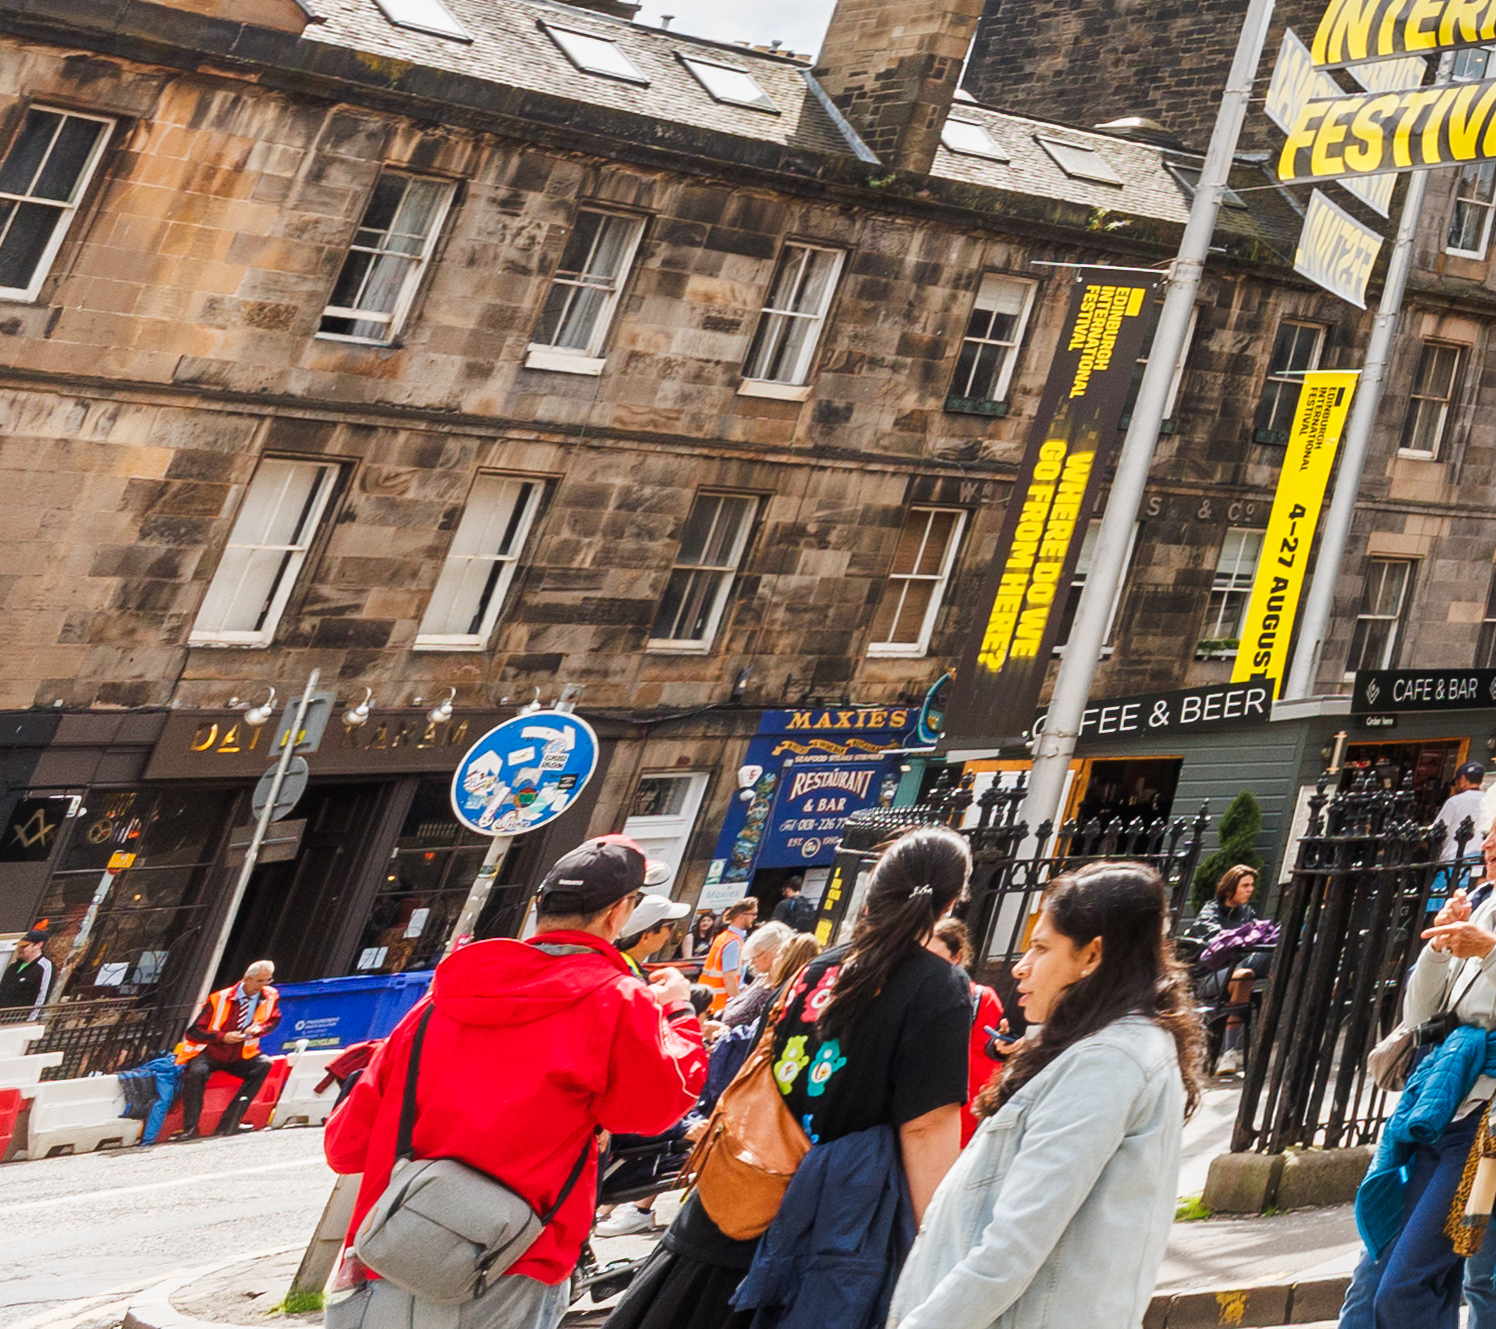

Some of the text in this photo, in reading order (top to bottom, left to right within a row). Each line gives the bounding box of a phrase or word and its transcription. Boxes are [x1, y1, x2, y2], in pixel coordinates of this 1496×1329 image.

[1067, 283, 1102, 352] FESTIVAL
[1069, 284, 1117, 399] INTERNATIONAL
[1093, 285, 1131, 371] EDINBURGH
[1298, 386, 1319, 437] FESTIVAL
[1299, 386, 1328, 472] INTERNATIONAL
[1314, 386, 1337, 451] EDINBURGH
[977, 438, 1068, 674] GO FROM HERE?
[1010, 450, 1095, 660] WHERE DO WE
[785, 710, 908, 730] MAXIES
[1148, 701, 1170, 729] &
[1181, 687, 1266, 724] BEER
[1393, 678, 1477, 702] CAFE & BAR
[787, 768, 875, 802] RESTAURANT
[803, 797, 847, 812] & BAR
